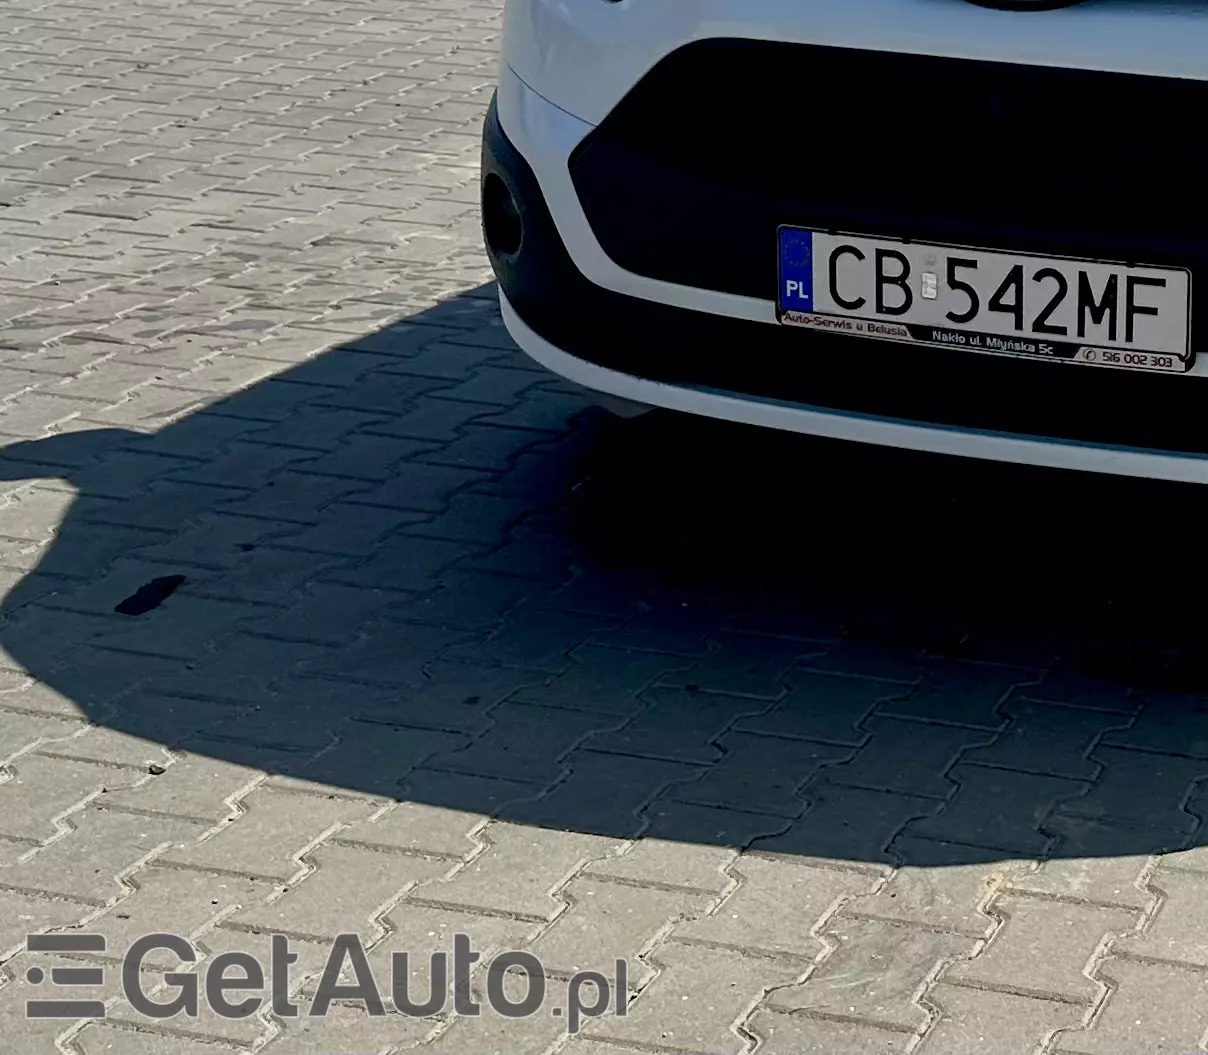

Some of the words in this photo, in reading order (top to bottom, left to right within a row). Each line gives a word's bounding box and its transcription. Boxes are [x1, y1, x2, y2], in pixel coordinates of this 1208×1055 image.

[786, 280, 809, 299] PL
[828, 244, 914, 316] CB
[945, 256, 1168, 343] 542MF
[784, 312, 852, 330] Auto-Serwis
[1123, 353, 1148, 365] 002
[1150, 356, 1173, 368] 303
